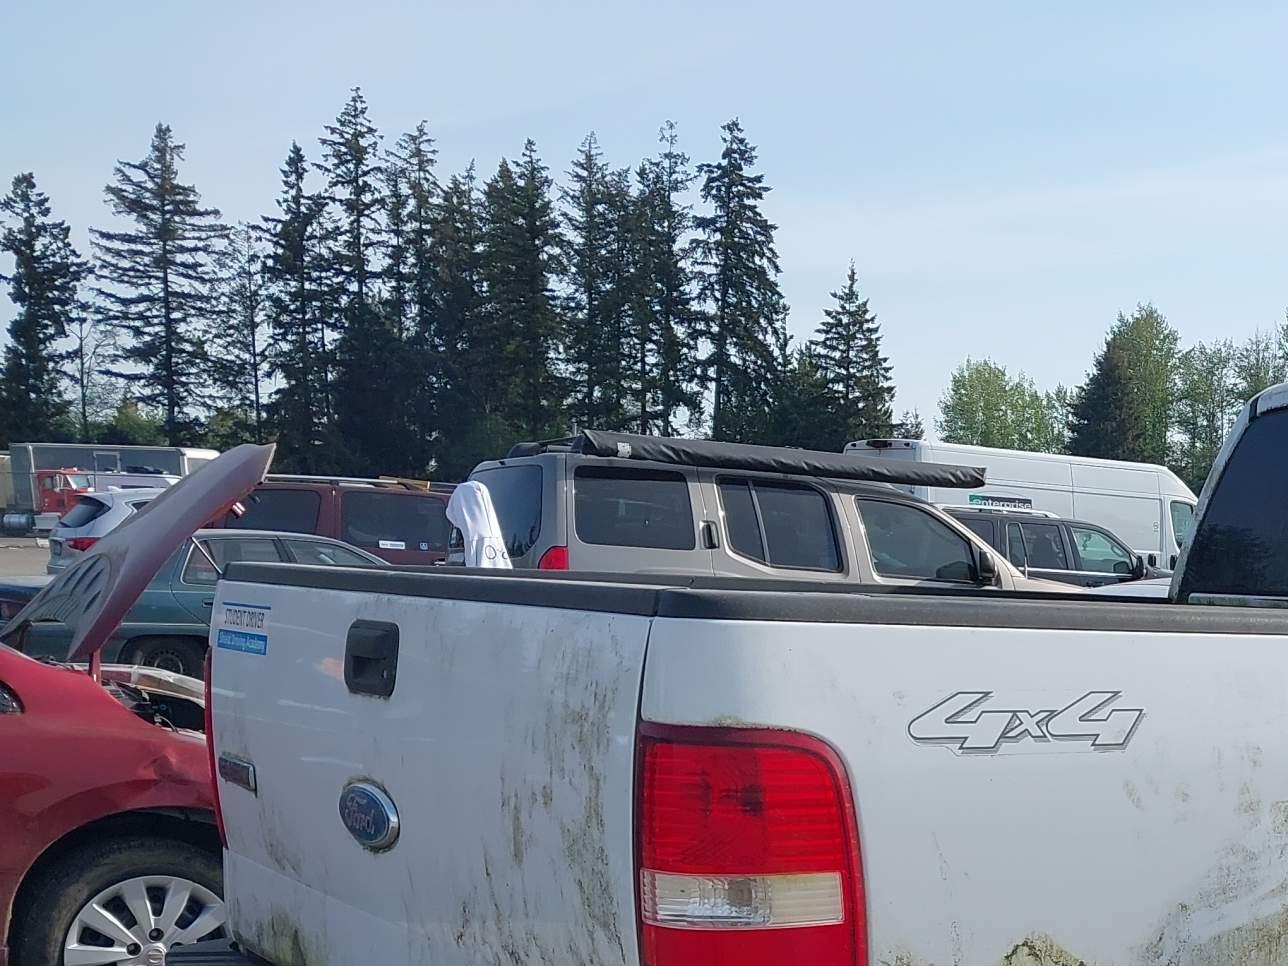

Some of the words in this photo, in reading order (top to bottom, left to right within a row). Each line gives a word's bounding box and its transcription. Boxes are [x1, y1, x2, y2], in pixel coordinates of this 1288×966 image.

[973, 499, 1032, 509] enterprise
[908, 691, 1146, 754] 4x4
[345, 793, 376, 834] Ford
